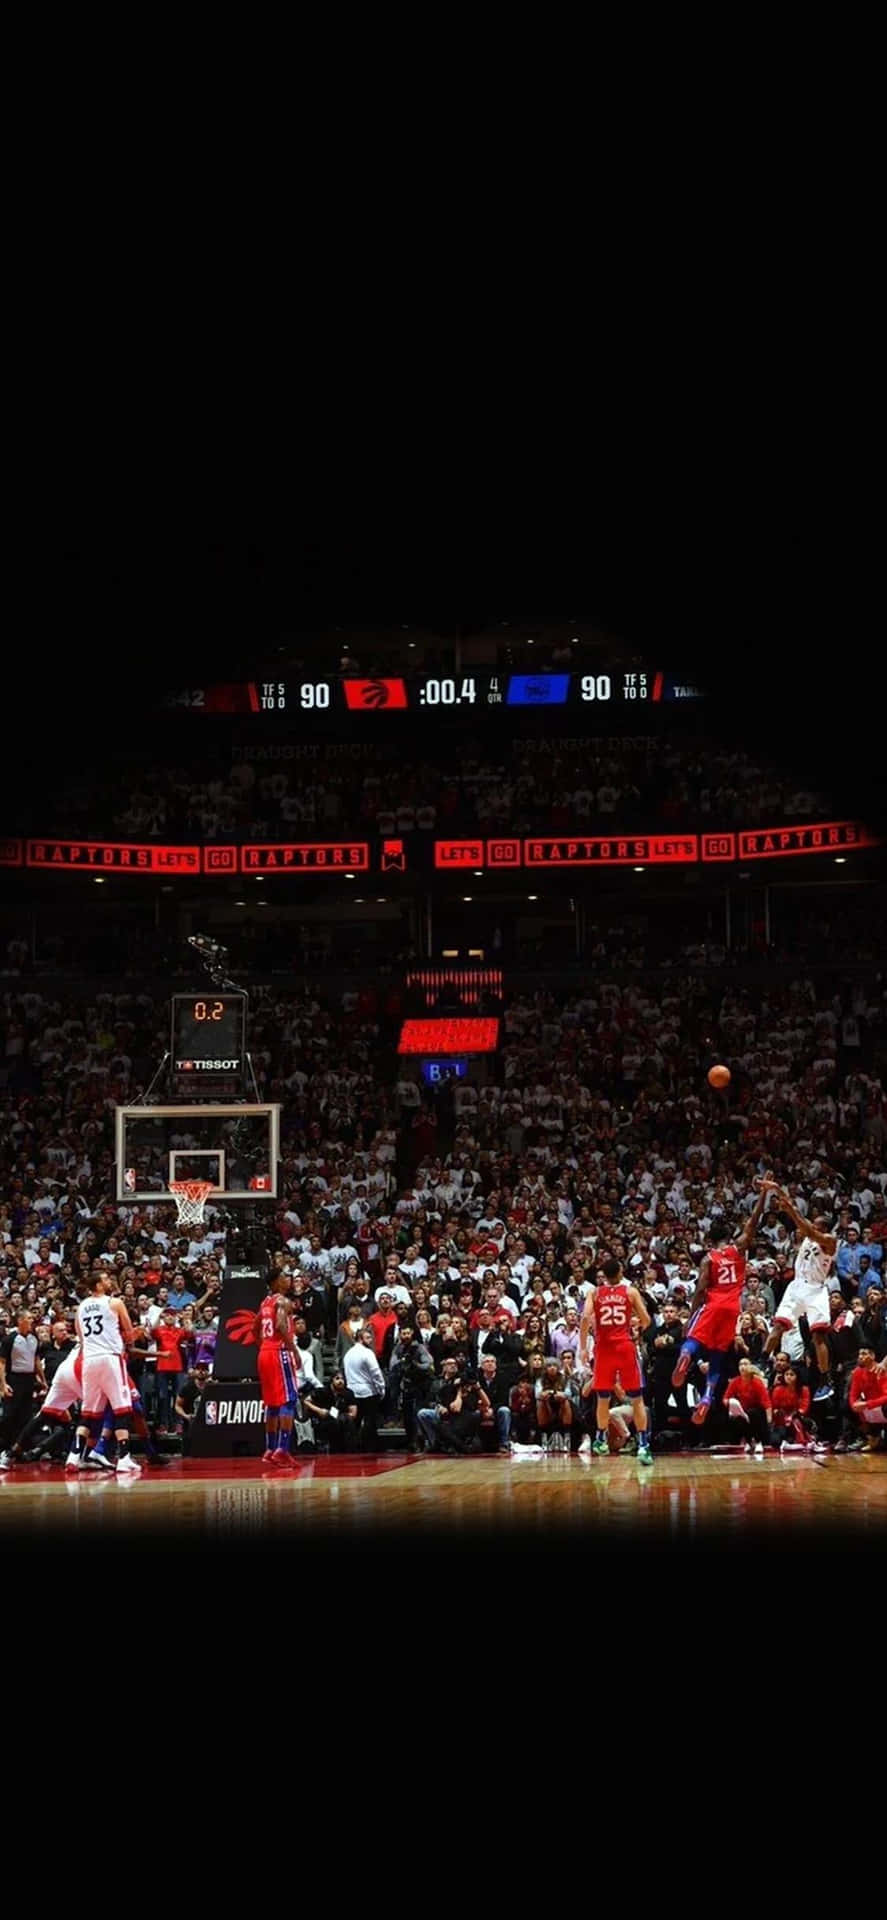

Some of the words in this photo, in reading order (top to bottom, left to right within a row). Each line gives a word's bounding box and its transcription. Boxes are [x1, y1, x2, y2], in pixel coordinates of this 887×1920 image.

[490, 678, 499, 690] 4
[581, 676, 611, 701] 90
[624, 674, 637, 686] TF
[639, 674, 647, 686] 5
[262, 684, 275, 696] TF
[278, 684, 285, 696] 5
[300, 683, 330, 709] 90
[419, 679, 476, 704] :00.4
[487, 693, 502, 703] QTR
[623, 687, 636, 700] TO
[639, 687, 647, 699] 0
[261, 697, 275, 709] TO
[278, 697, 285, 709] 0
[494, 845, 514, 860] GO
[533, 841, 646, 859] RAPTORS
[708, 839, 729, 854] GO
[746, 825, 856, 852] RAPTORS
[34, 845, 149, 865] RAPTORS
[211, 852, 231, 867] GO
[249, 849, 361, 866] RAPTORS
[195, 1002, 224, 1020] 0.2
[193, 1060, 240, 1070] TISSOT
[717, 1265, 738, 1284] 21
[599, 1305, 627, 1326] 25
[82, 1314, 104, 1337] 33
